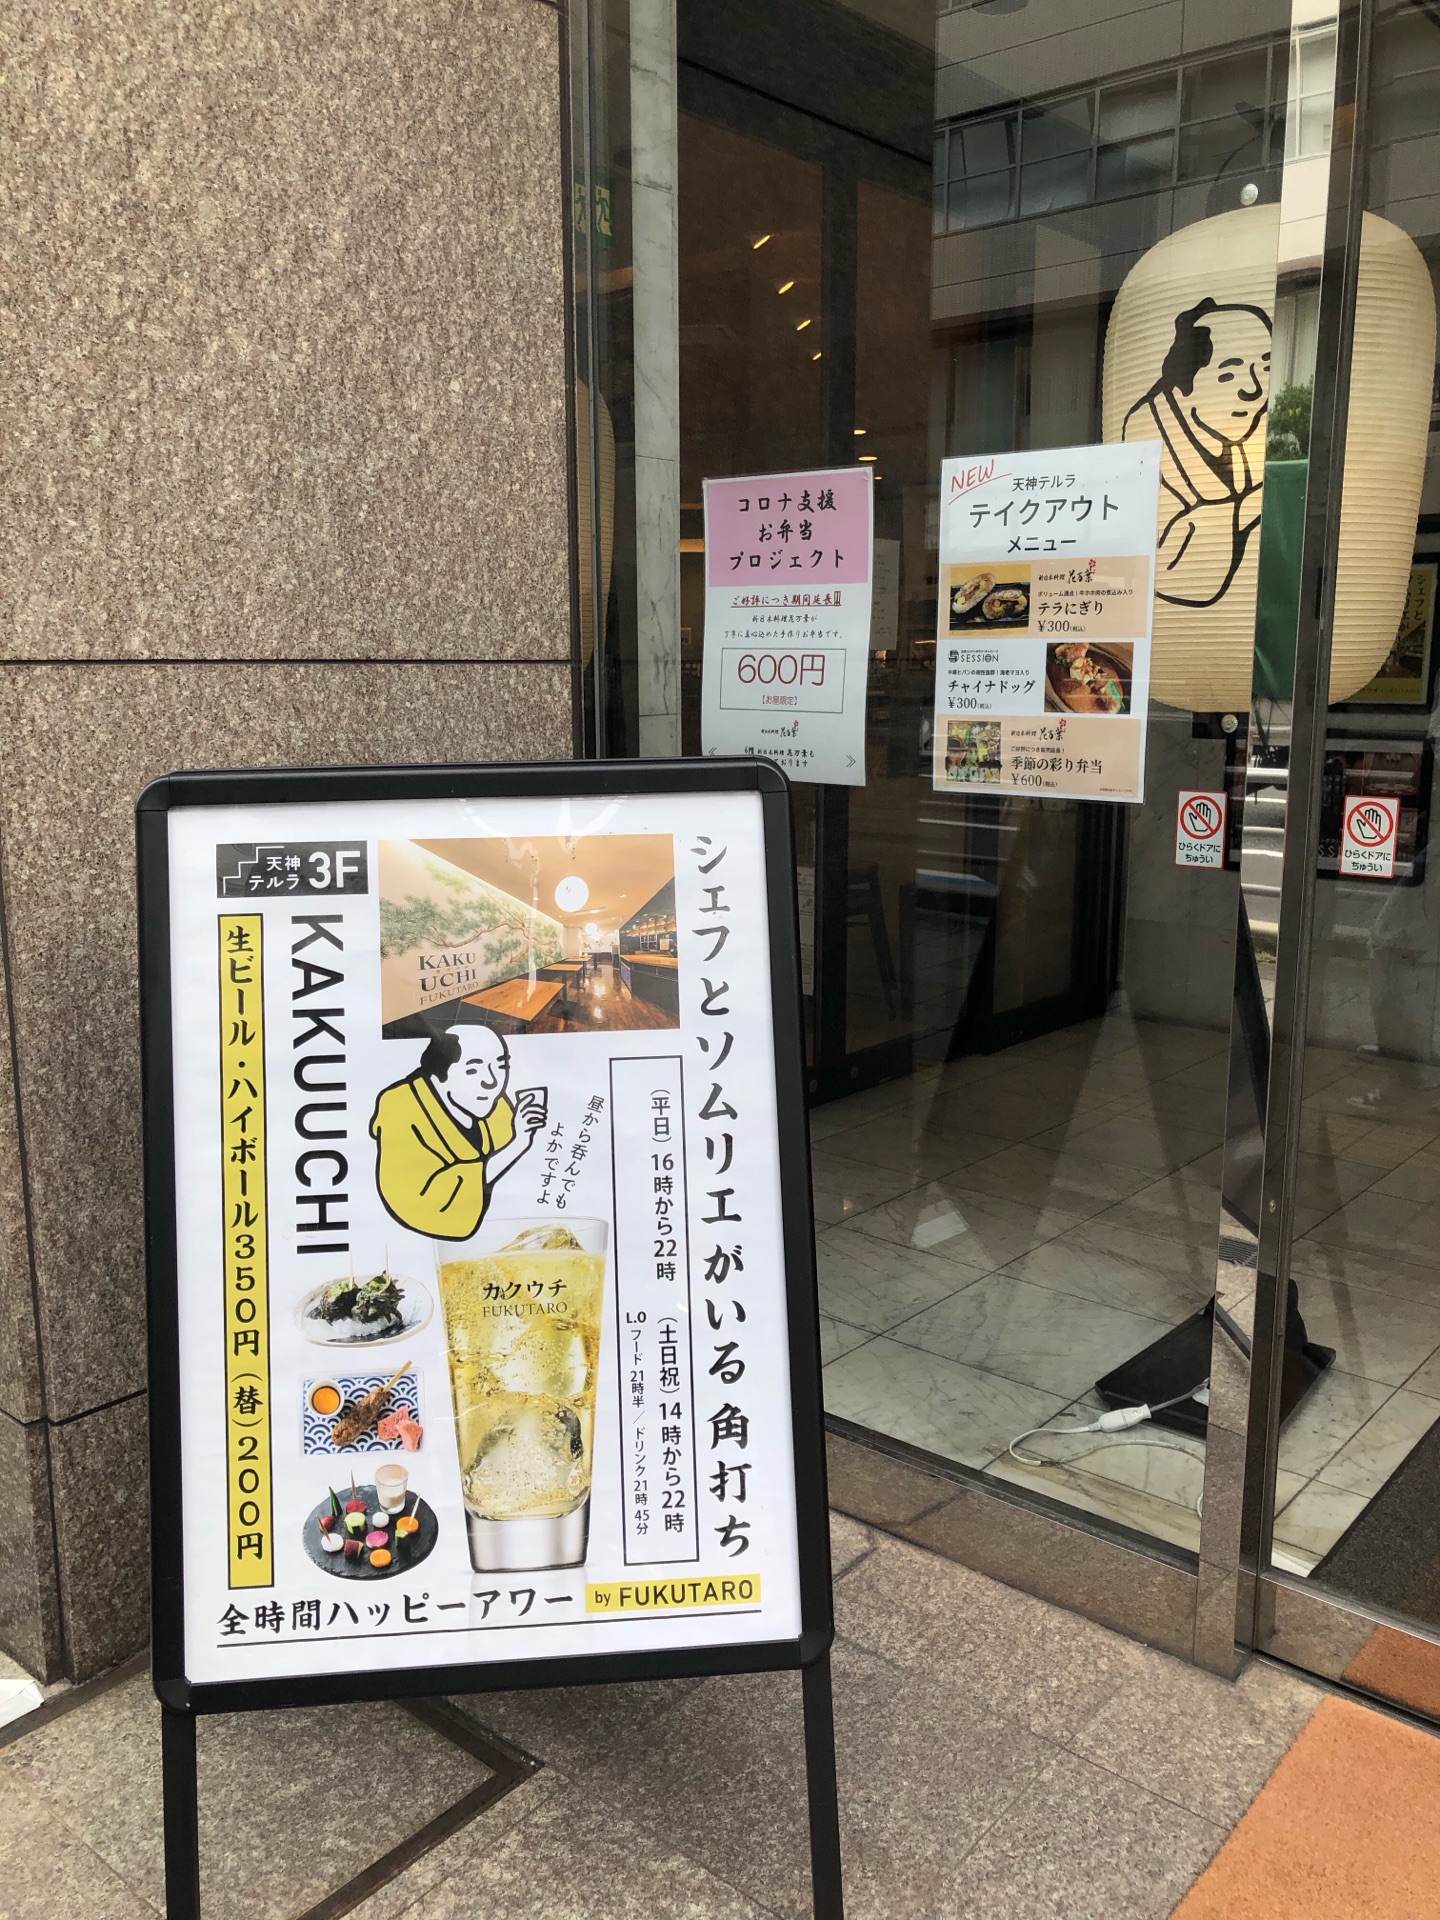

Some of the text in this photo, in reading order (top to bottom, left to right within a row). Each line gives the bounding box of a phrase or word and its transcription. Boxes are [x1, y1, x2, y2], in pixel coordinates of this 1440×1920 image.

[951, 459, 995, 493] NEW
[1012, 474, 1076, 491] 天神テルラ
[738, 489, 837, 513] コロナ支援
[969, 494, 1118, 528] テイクアウト
[758, 519, 813, 543] お弁当
[1007, 535, 1077, 553] メニュー
[729, 549, 844, 571] プロジェクト
[1038, 600, 1103, 615] テラにぎり
[960, 653, 999, 663] SESSION
[738, 654, 826, 686] 600円
[948, 680, 1036, 694] チャイナドッグ
[1010, 756, 1102, 774] 季節の彩り弁当
[1178, 842, 1221, 853] ひらくドアに
[1344, 849, 1392, 862] ひらくドアに
[266, 855, 301, 871] 天神
[308, 850, 361, 889] 3F
[1185, 854, 1214, 864] ちゅうい
[1351, 861, 1383, 872] ちゅうい
[249, 874, 300, 891] テルラ
[418, 952, 476, 971] KAKU
[419, 969, 477, 992] UCHI
[420, 981, 479, 1006] FUKUTARO
[291, 914, 350, 1254] KAKUUCHI
[555, 1095, 605, 1209] 昼から呑んでも
[536, 1122, 564, 1205] よかですよ
[690, 835, 752, 1558] シェフとソムリエがいる角打ち
[482, 1278, 568, 1300] カクウチ
[482, 1302, 568, 1317] FUKUTARO
[594, 1579, 753, 1608] by FUKUTARO
[217, 1586, 575, 1638] 全時間ハッピーアワー
